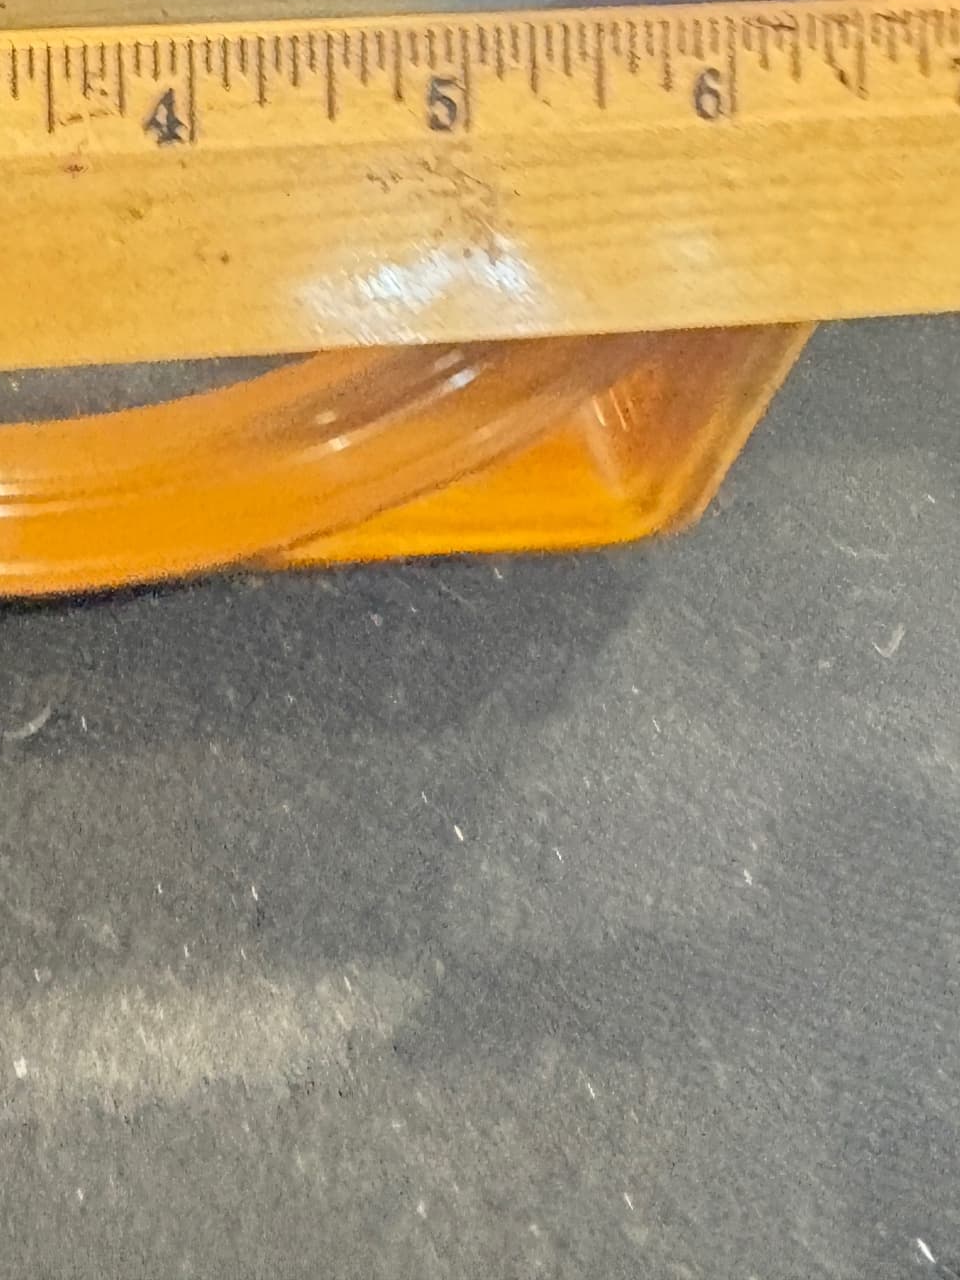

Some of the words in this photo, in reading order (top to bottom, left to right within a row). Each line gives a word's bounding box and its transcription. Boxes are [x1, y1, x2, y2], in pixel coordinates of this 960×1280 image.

[144, 87, 188, 145] 4
[427, 75, 462, 131] 5
[695, 66, 725, 120] 6
